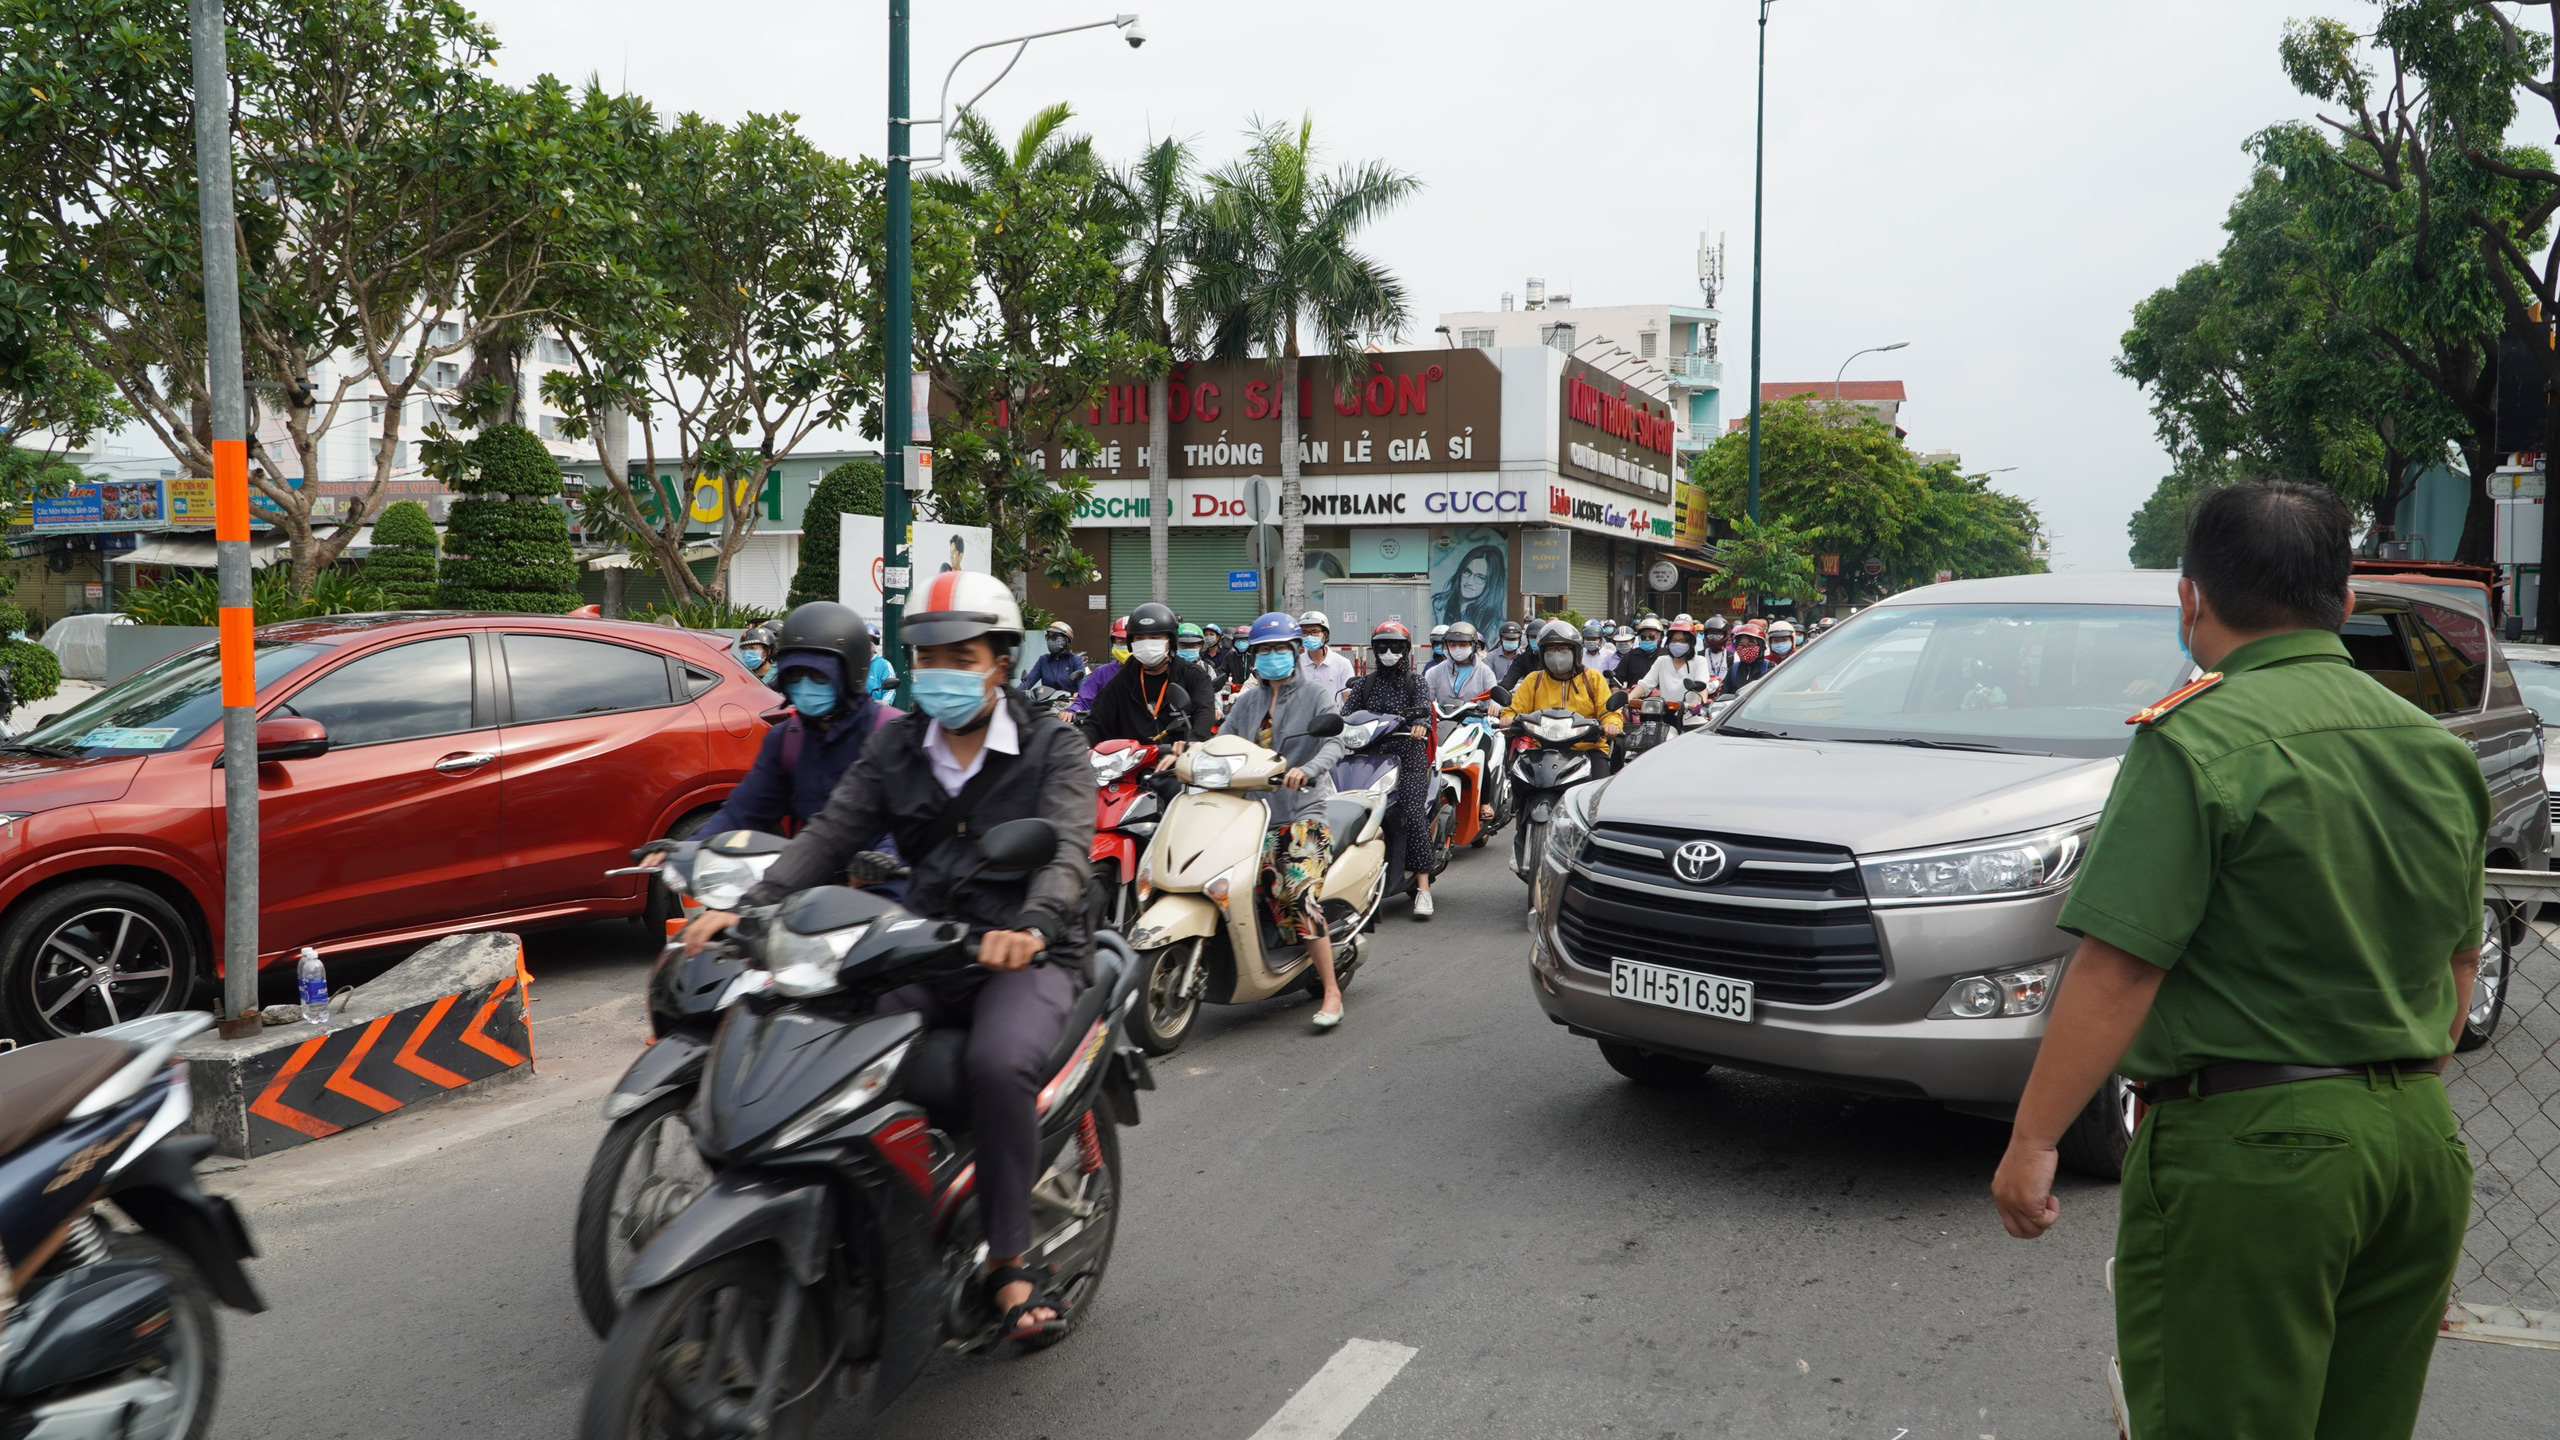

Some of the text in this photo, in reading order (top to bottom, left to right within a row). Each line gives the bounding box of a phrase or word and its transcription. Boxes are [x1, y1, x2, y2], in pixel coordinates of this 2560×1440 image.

[1183, 430, 1264, 466] THỐNG
[1280, 434, 1328, 464] ÁN
[1344, 430, 1372, 462] LẺ
[1388, 431, 1431, 461] GIÁ
[1448, 426, 1473, 460] SỈ
[1279, 493, 1406, 516] ONTBLANC
[1424, 490, 1528, 513] GUCCI
[1572, 497, 1604, 525] LACOSTE
[1615, 963, 1747, 1018] 51H-516.95
